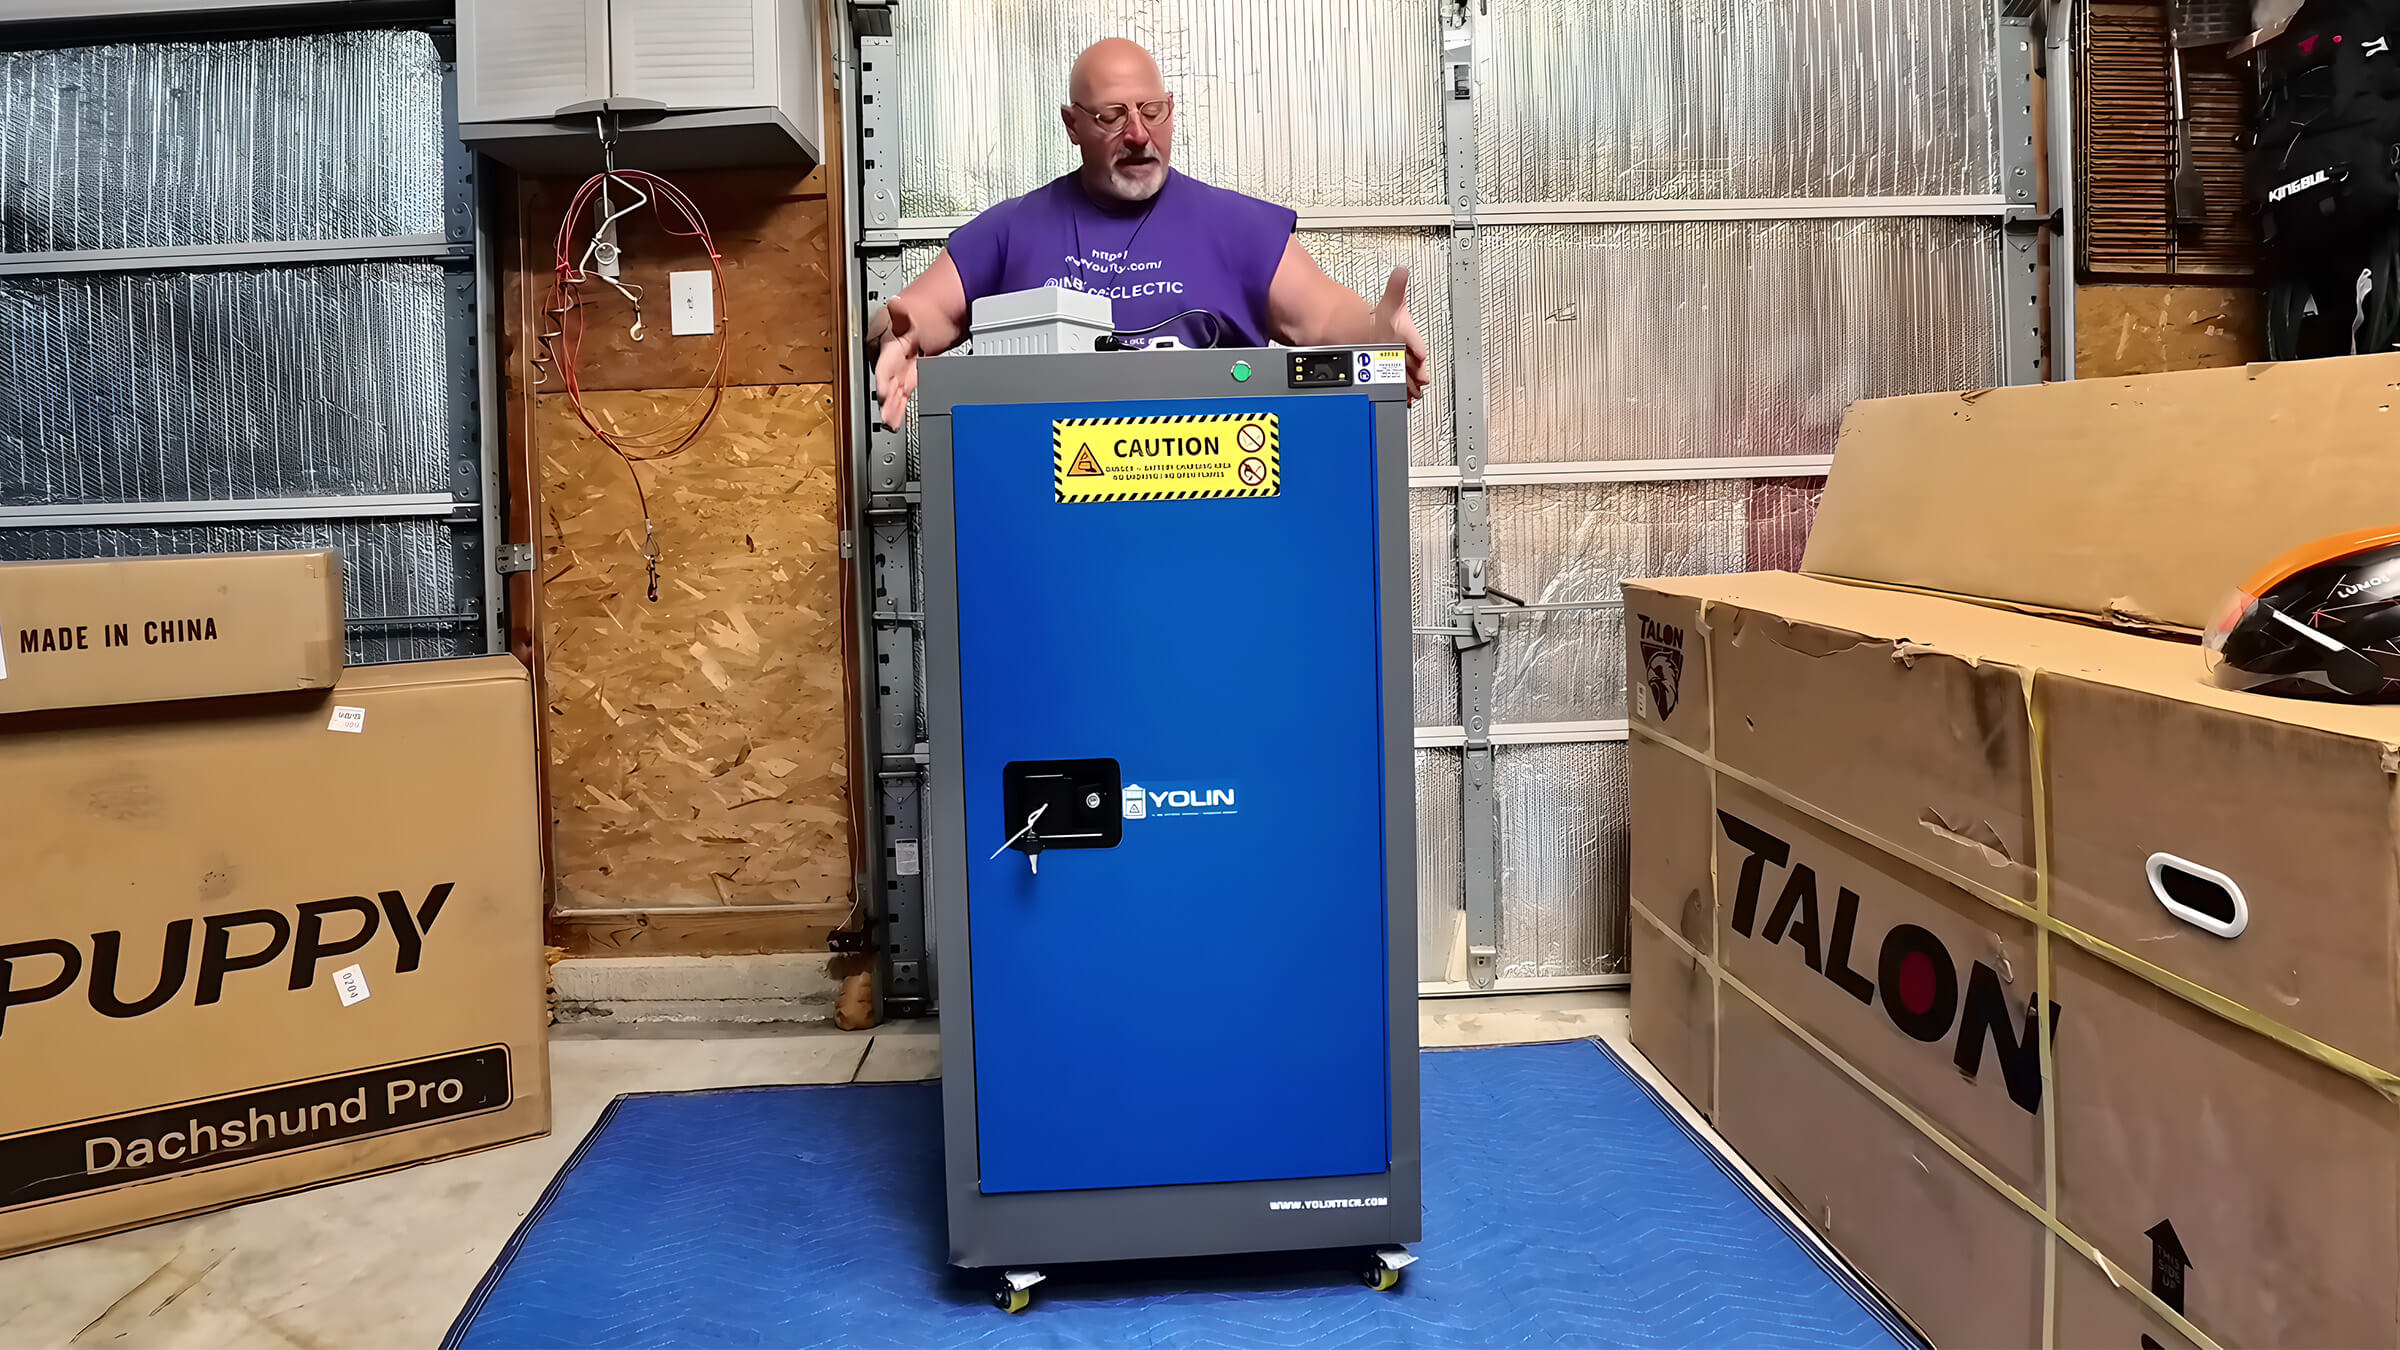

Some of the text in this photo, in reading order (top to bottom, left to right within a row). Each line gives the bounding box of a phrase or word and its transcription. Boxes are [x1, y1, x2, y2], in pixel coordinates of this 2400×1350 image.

[1113, 436, 1219, 458] CAUTION
[20, 617, 218, 653] MADE IN CHINA
[1637, 613, 1684, 650] TALON
[1148, 788, 1235, 808] YOLIN
[0, 882, 456, 1037] PUPPY
[1716, 808, 2062, 1116] TALON
[85, 1078, 463, 1175] Dachshund Pro
